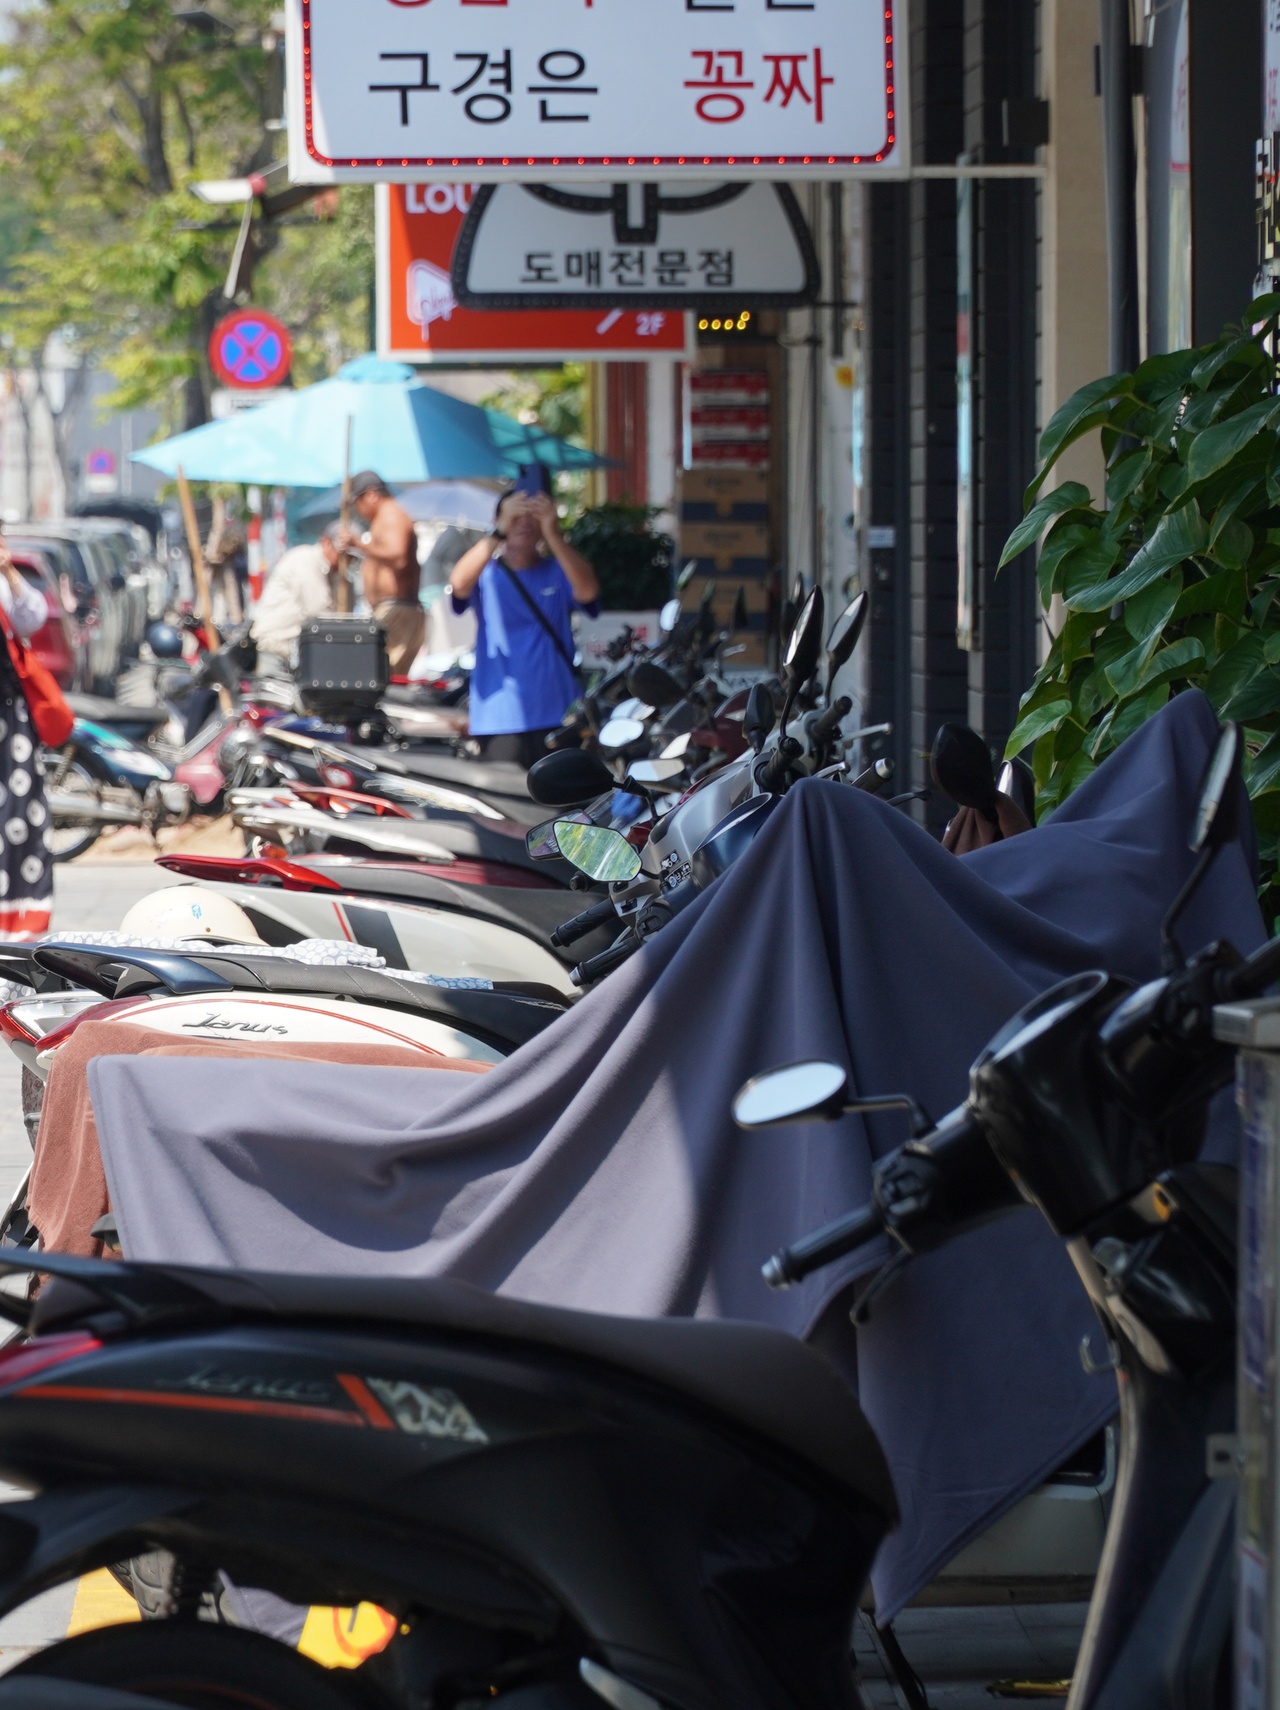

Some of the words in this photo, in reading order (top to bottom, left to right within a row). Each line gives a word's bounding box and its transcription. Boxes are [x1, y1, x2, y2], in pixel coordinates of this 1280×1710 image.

[369, 49, 598, 126] 구경은
[684, 48, 834, 124] 꽁짜
[521, 250, 734, 288] 도매전문점
[635, 311, 665, 336] 2F
[181, 1012, 290, 1035] Janus
